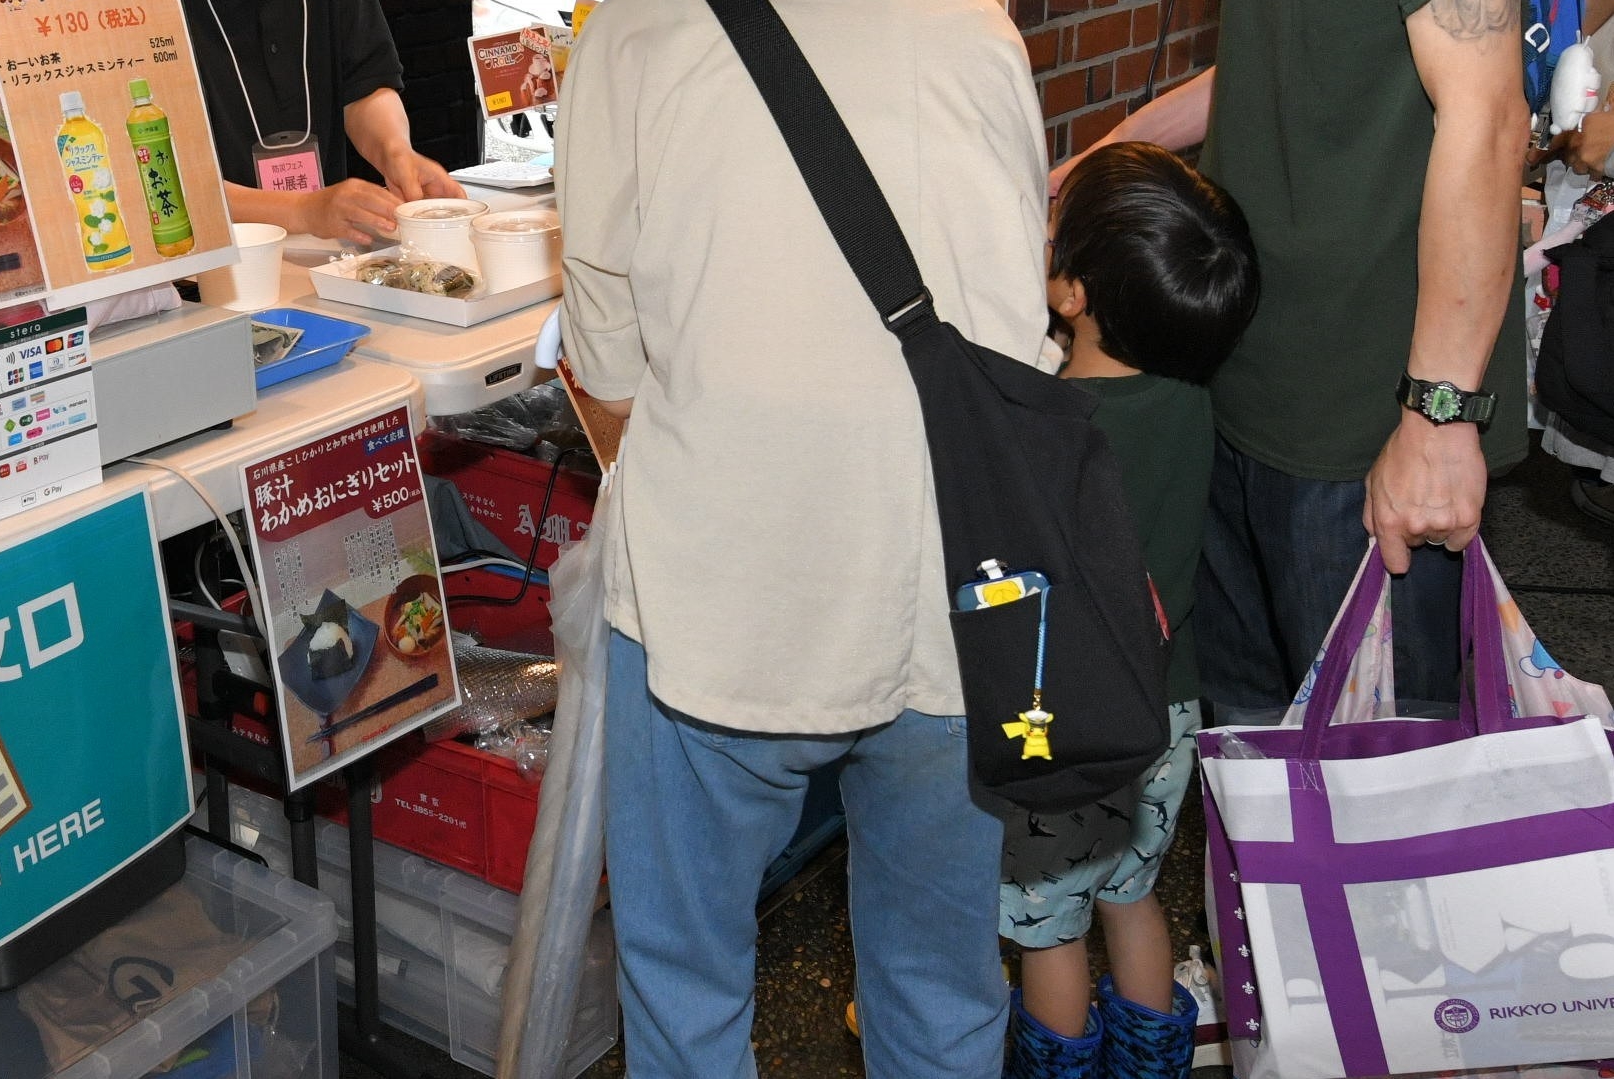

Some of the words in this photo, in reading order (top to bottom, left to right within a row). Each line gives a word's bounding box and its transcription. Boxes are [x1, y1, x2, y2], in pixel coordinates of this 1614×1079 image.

[149, 36, 175, 49] 525ml
[153, 51, 178, 64] 600ml
[478, 43, 525, 60] CINNAMON
[273, 173, 308, 190] 出展者
[10, 324, 42, 339] stera
[19, 345, 42, 360] VISA
[253, 416, 399, 480] 石川県産こしひかりと加賀味噌を使用した
[254, 474, 294, 508] 豚汁
[261, 451, 415, 532] わかめおにぎりセット
[394, 798, 412, 810] TEL
[12, 798, 105, 873] HERE
[1489, 1002, 1557, 1020] RIKKYO
